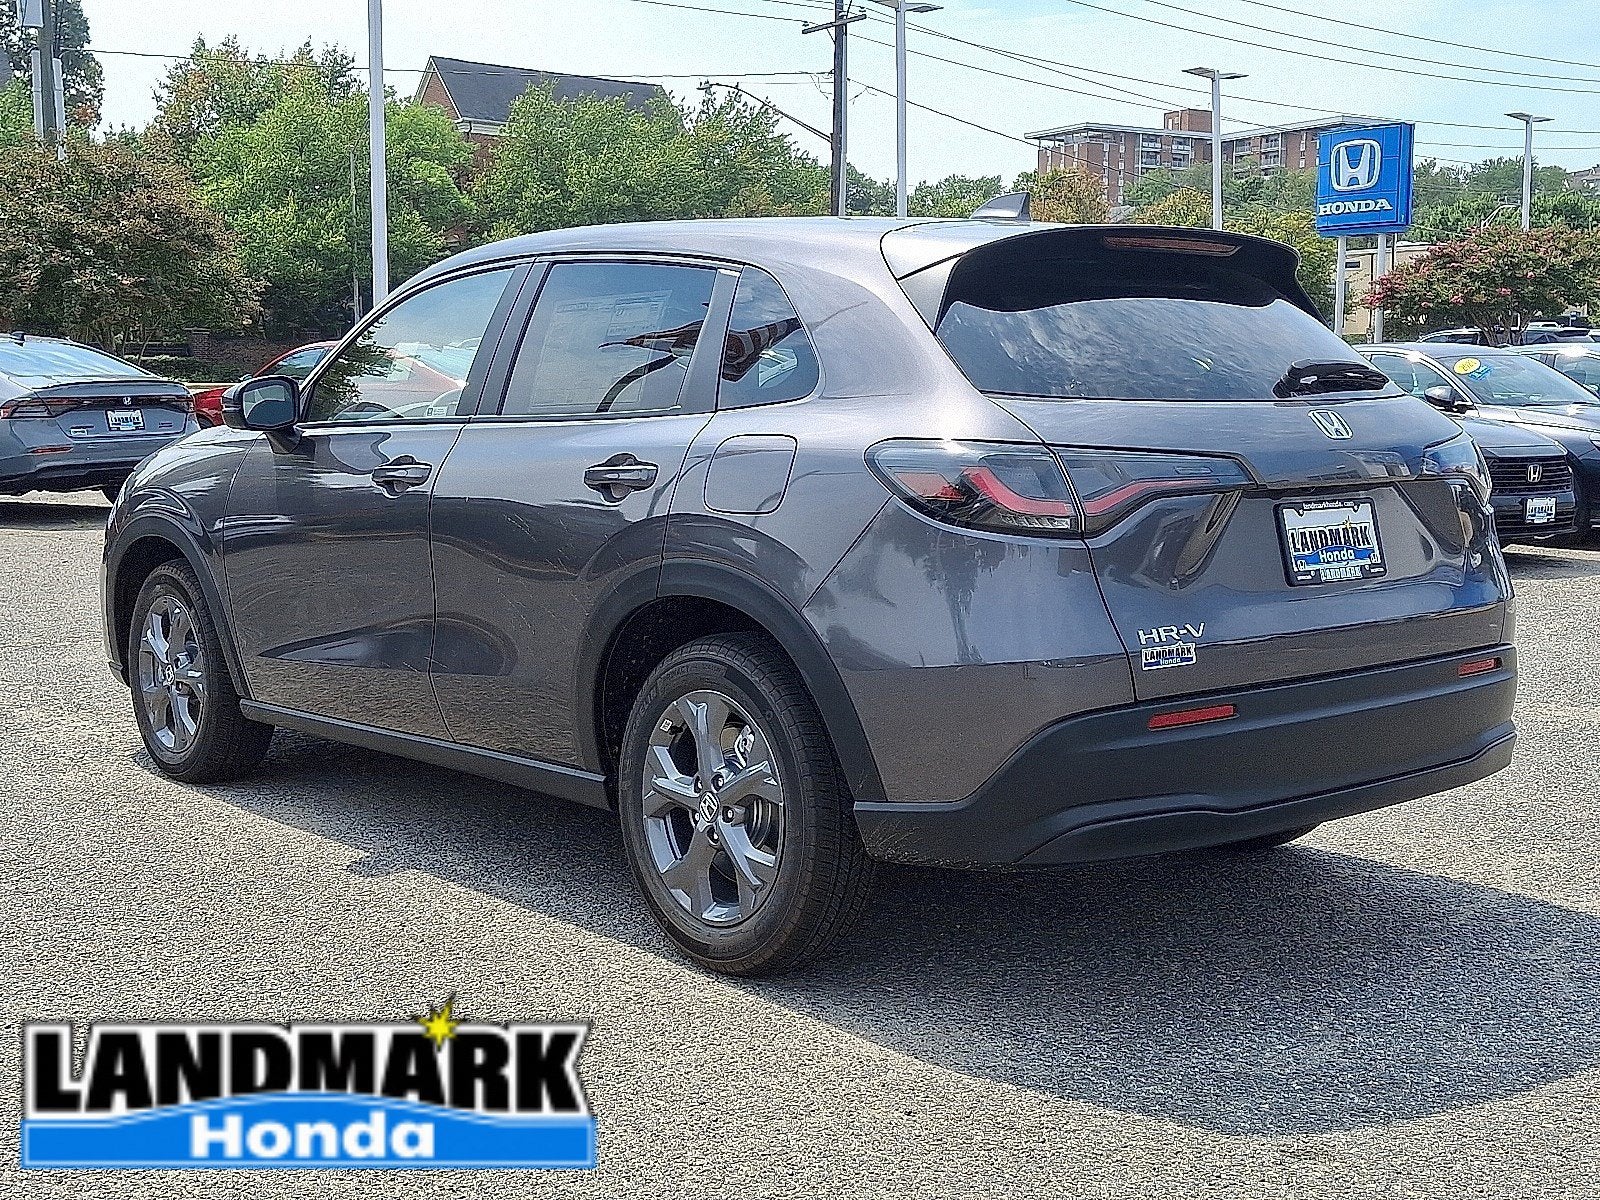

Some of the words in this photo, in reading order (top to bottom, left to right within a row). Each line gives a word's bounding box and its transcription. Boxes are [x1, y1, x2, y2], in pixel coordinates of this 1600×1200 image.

[1318, 199, 1393, 216] HONDA
[1290, 525, 1373, 554] LANDMARK
[1319, 547, 1356, 563] Honda
[1137, 622, 1206, 645] HR-V
[1144, 646, 1193, 661] LANDMARK
